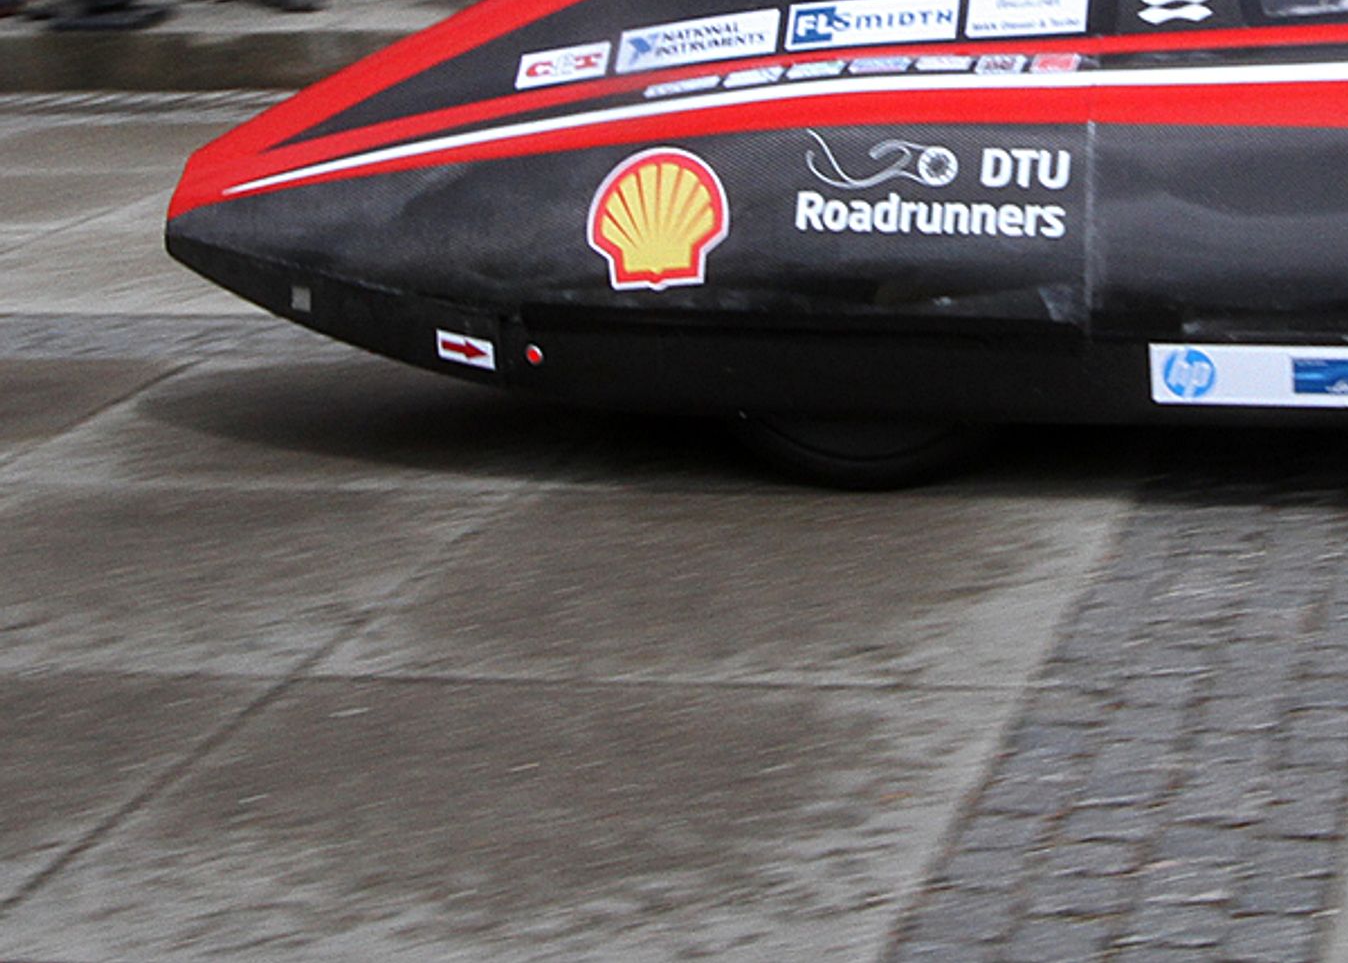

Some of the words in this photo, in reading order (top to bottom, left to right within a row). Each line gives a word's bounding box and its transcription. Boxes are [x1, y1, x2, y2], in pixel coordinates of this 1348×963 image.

[661, 21, 740, 42] NATIONAL
[981, 147, 1071, 189] DTU
[795, 190, 1066, 238] Roadrunners
